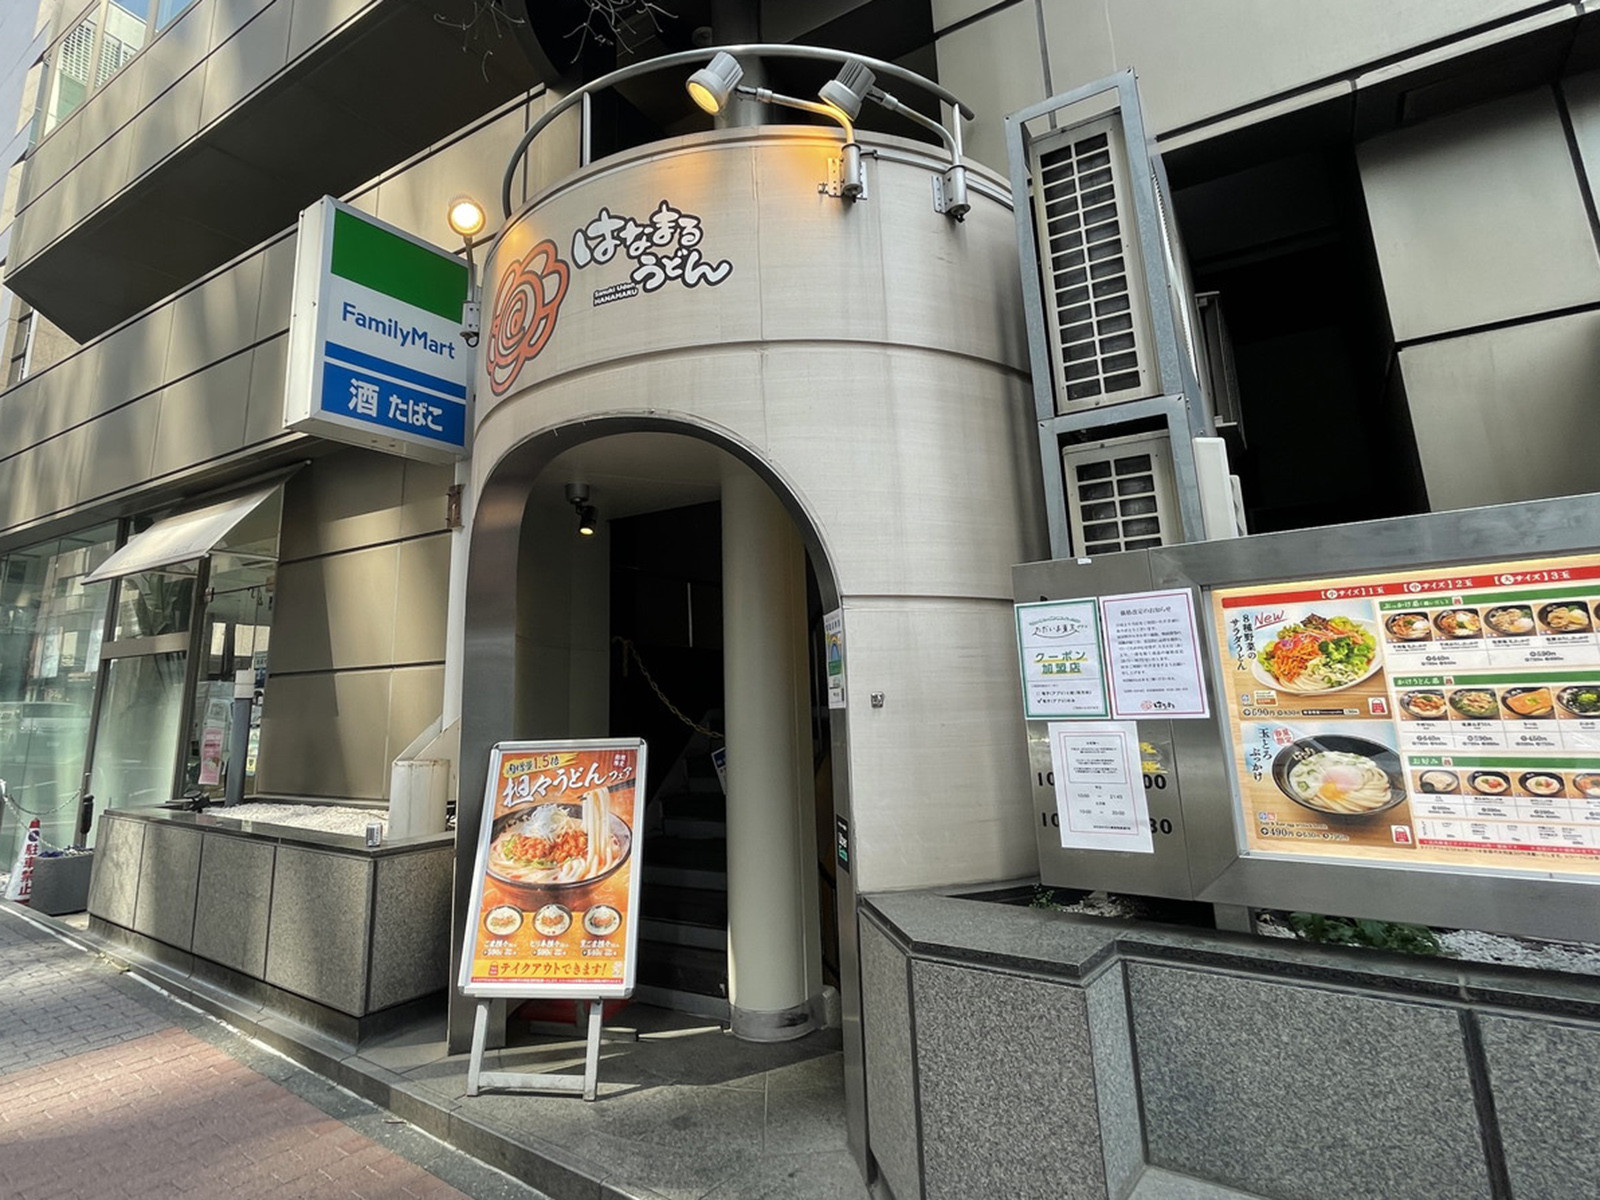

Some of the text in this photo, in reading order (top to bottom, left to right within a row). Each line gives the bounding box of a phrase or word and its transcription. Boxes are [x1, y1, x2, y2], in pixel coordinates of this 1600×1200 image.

[572, 200, 703, 268] はなまる
[631, 248, 733, 292] うどん
[594, 282, 636, 298] Sanuki Udon
[594, 288, 638, 305] HANAMARU
[342, 301, 455, 359] FamilyMart
[348, 378, 443, 432] 酒 たばこ
[1254, 610, 1285, 627] New
[1035, 650, 1086, 662] クーポン
[1230, 618, 1247, 671] サラダうどん
[1042, 662, 1081, 674] 加盟店
[1259, 727, 1272, 760] 玉とろ
[1249, 747, 1263, 781] ぶっかけ
